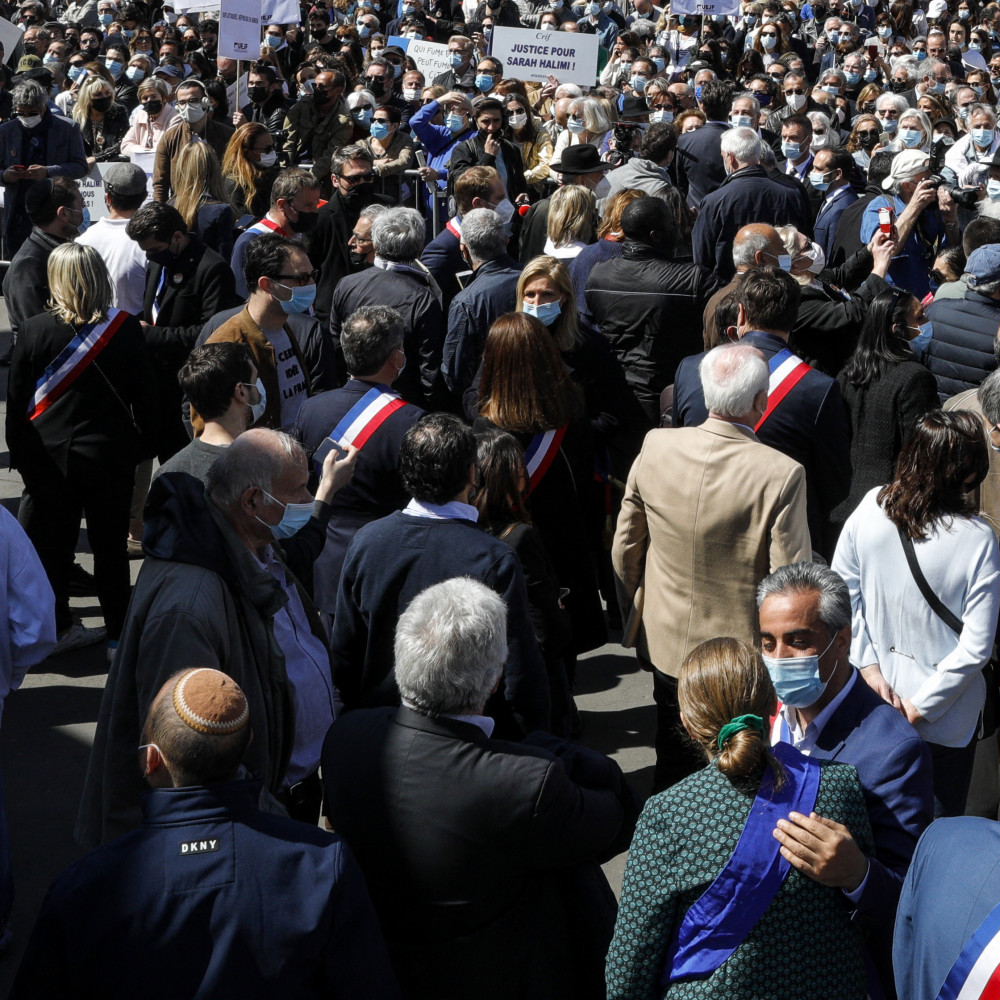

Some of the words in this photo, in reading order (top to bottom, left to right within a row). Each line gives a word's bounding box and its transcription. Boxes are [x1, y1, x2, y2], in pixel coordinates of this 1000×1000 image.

[535, 32, 553, 42] Crif
[414, 45, 425, 53] QUI
[427, 48, 444, 57] FUME
[511, 44, 549, 55] JUSTICE
[551, 47, 576, 58] POUR
[417, 57, 434, 67] PEUT
[434, 60, 452, 69] FUME
[507, 56, 537, 67] SARAH
[539, 59, 571, 70] HALIMI
[181, 839, 217, 853] DKNY
